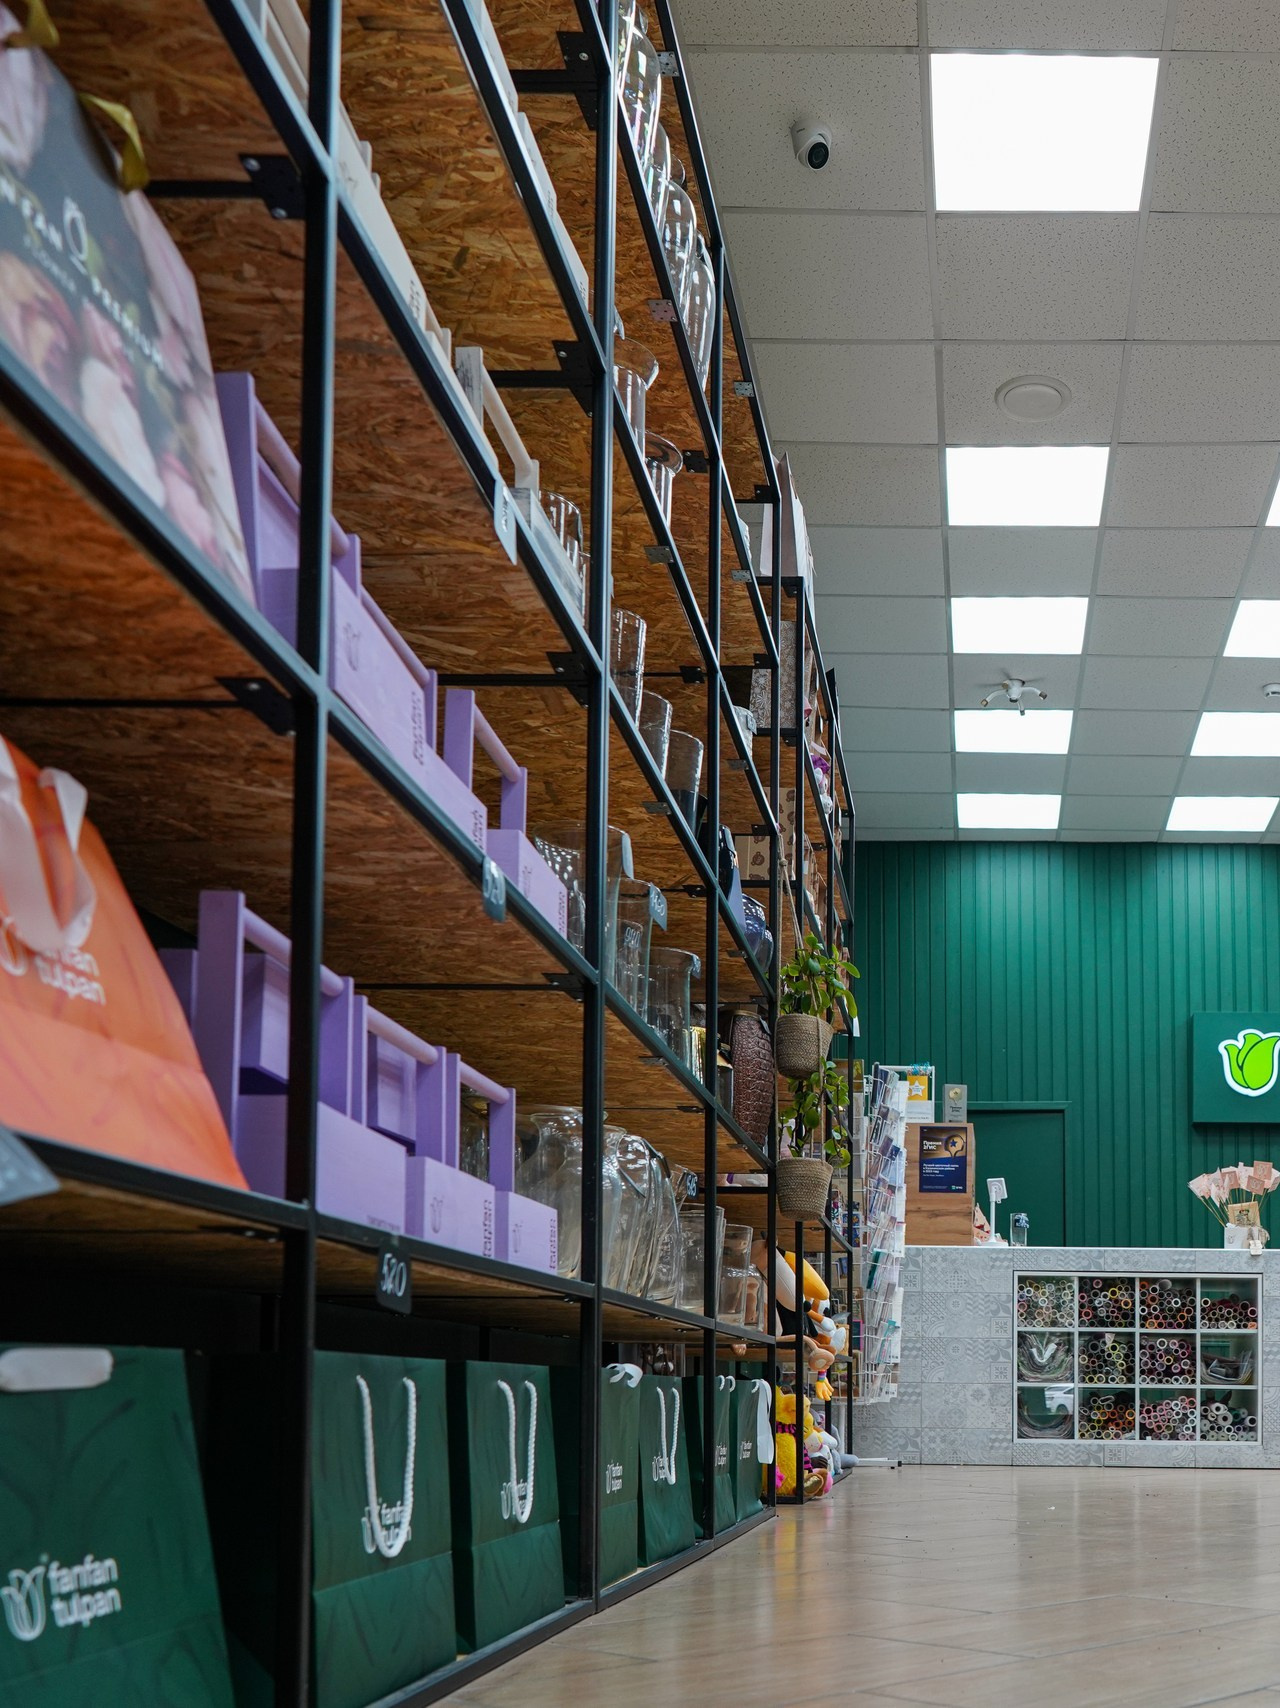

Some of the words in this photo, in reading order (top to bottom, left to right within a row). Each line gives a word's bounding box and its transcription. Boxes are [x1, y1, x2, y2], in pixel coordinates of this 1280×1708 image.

[34, 954, 107, 1007] tulpan
[612, 1462, 623, 1477] fanfan
[612, 1477, 623, 1493] tulpan
[47, 1553, 118, 1596] fanfan
[50, 1588, 122, 1628] tulpan
